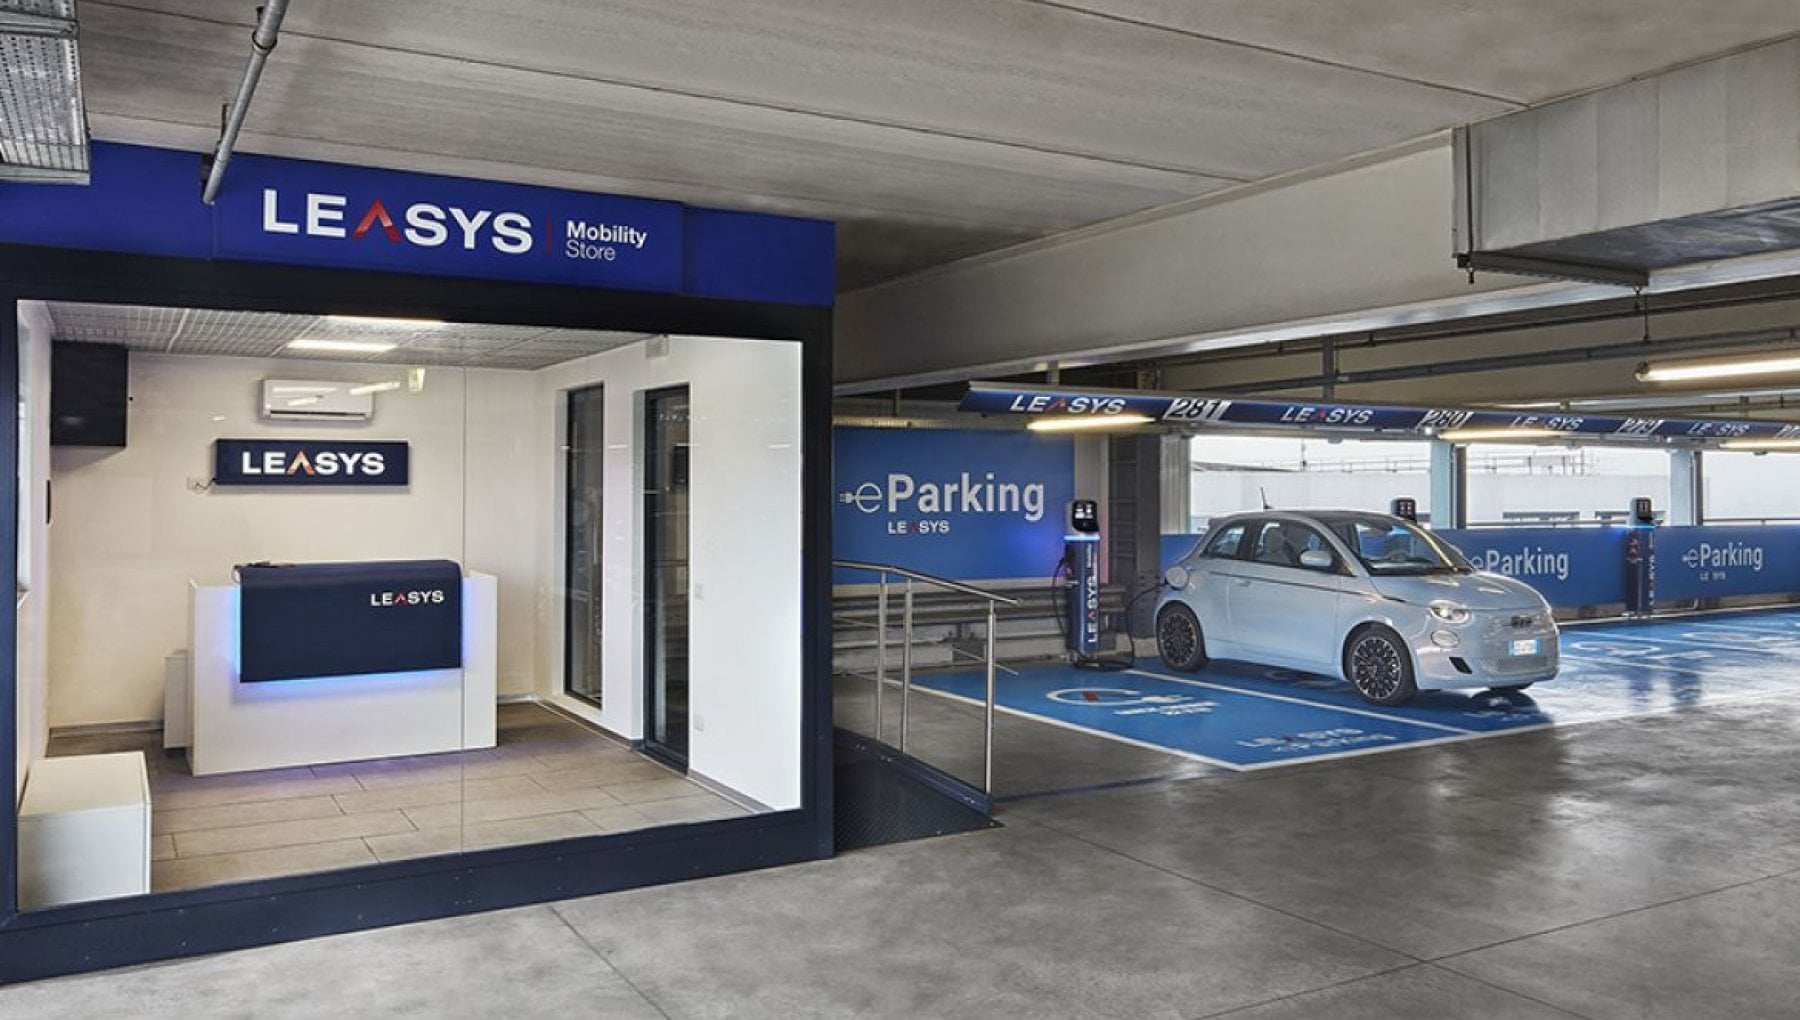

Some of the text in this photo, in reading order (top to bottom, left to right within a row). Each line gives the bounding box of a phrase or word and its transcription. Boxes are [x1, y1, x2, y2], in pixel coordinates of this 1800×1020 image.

[263, 188, 533, 255] LEASYS
[565, 220, 648, 248] Mobility
[565, 239, 617, 261] Store
[1009, 394, 1127, 415] LEASYS
[1167, 398, 1221, 418] 281
[242, 450, 386, 476] LEASYS
[887, 520, 950, 535] LEASYS
[369, 590, 445, 607] LEASYS
[1087, 576, 1098, 643] LEASYS
